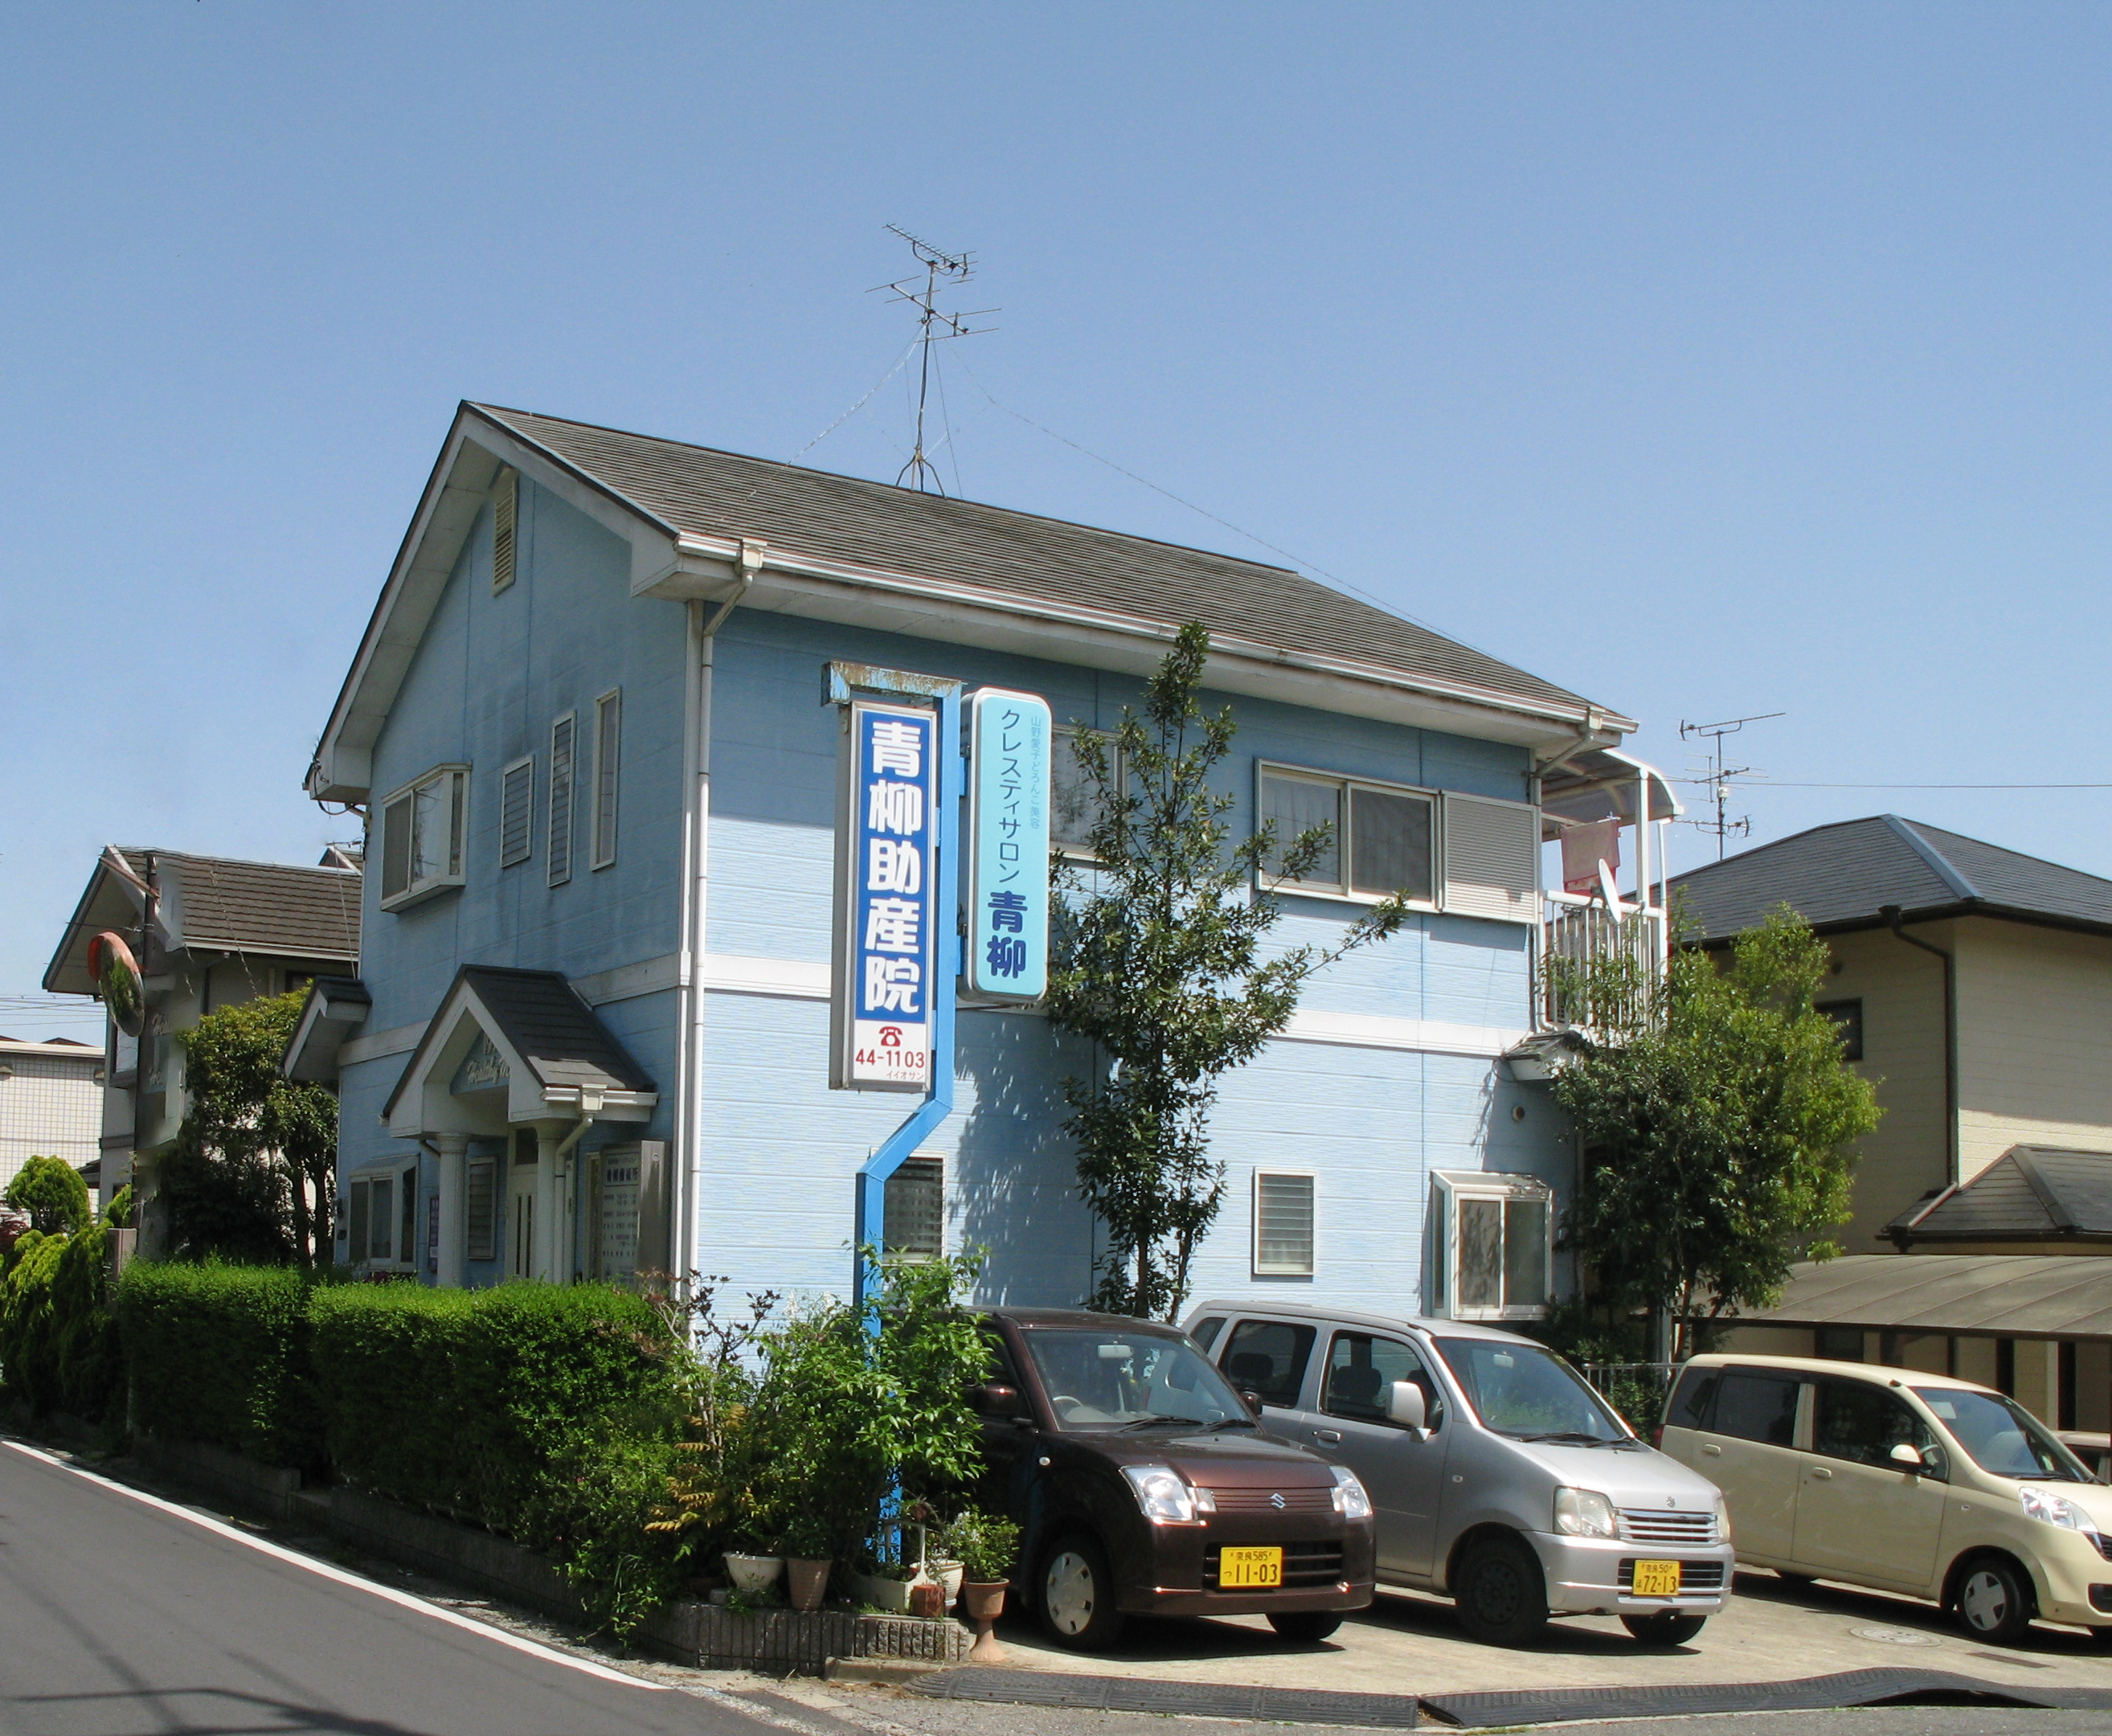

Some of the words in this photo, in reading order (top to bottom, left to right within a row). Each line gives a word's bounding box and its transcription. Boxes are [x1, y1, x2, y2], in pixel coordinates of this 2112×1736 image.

[998, 709, 1021, 883] クレスティサロン
[866, 721, 922, 1013] 青柳助産院
[986, 890, 1028, 980] 青柳
[855, 1048, 925, 1068] 44-1103
[886, 1070, 924, 1081] イイオサン
[1236, 1563, 1278, 1583] 11-03
[1643, 1575, 1676, 1593] 72-13
